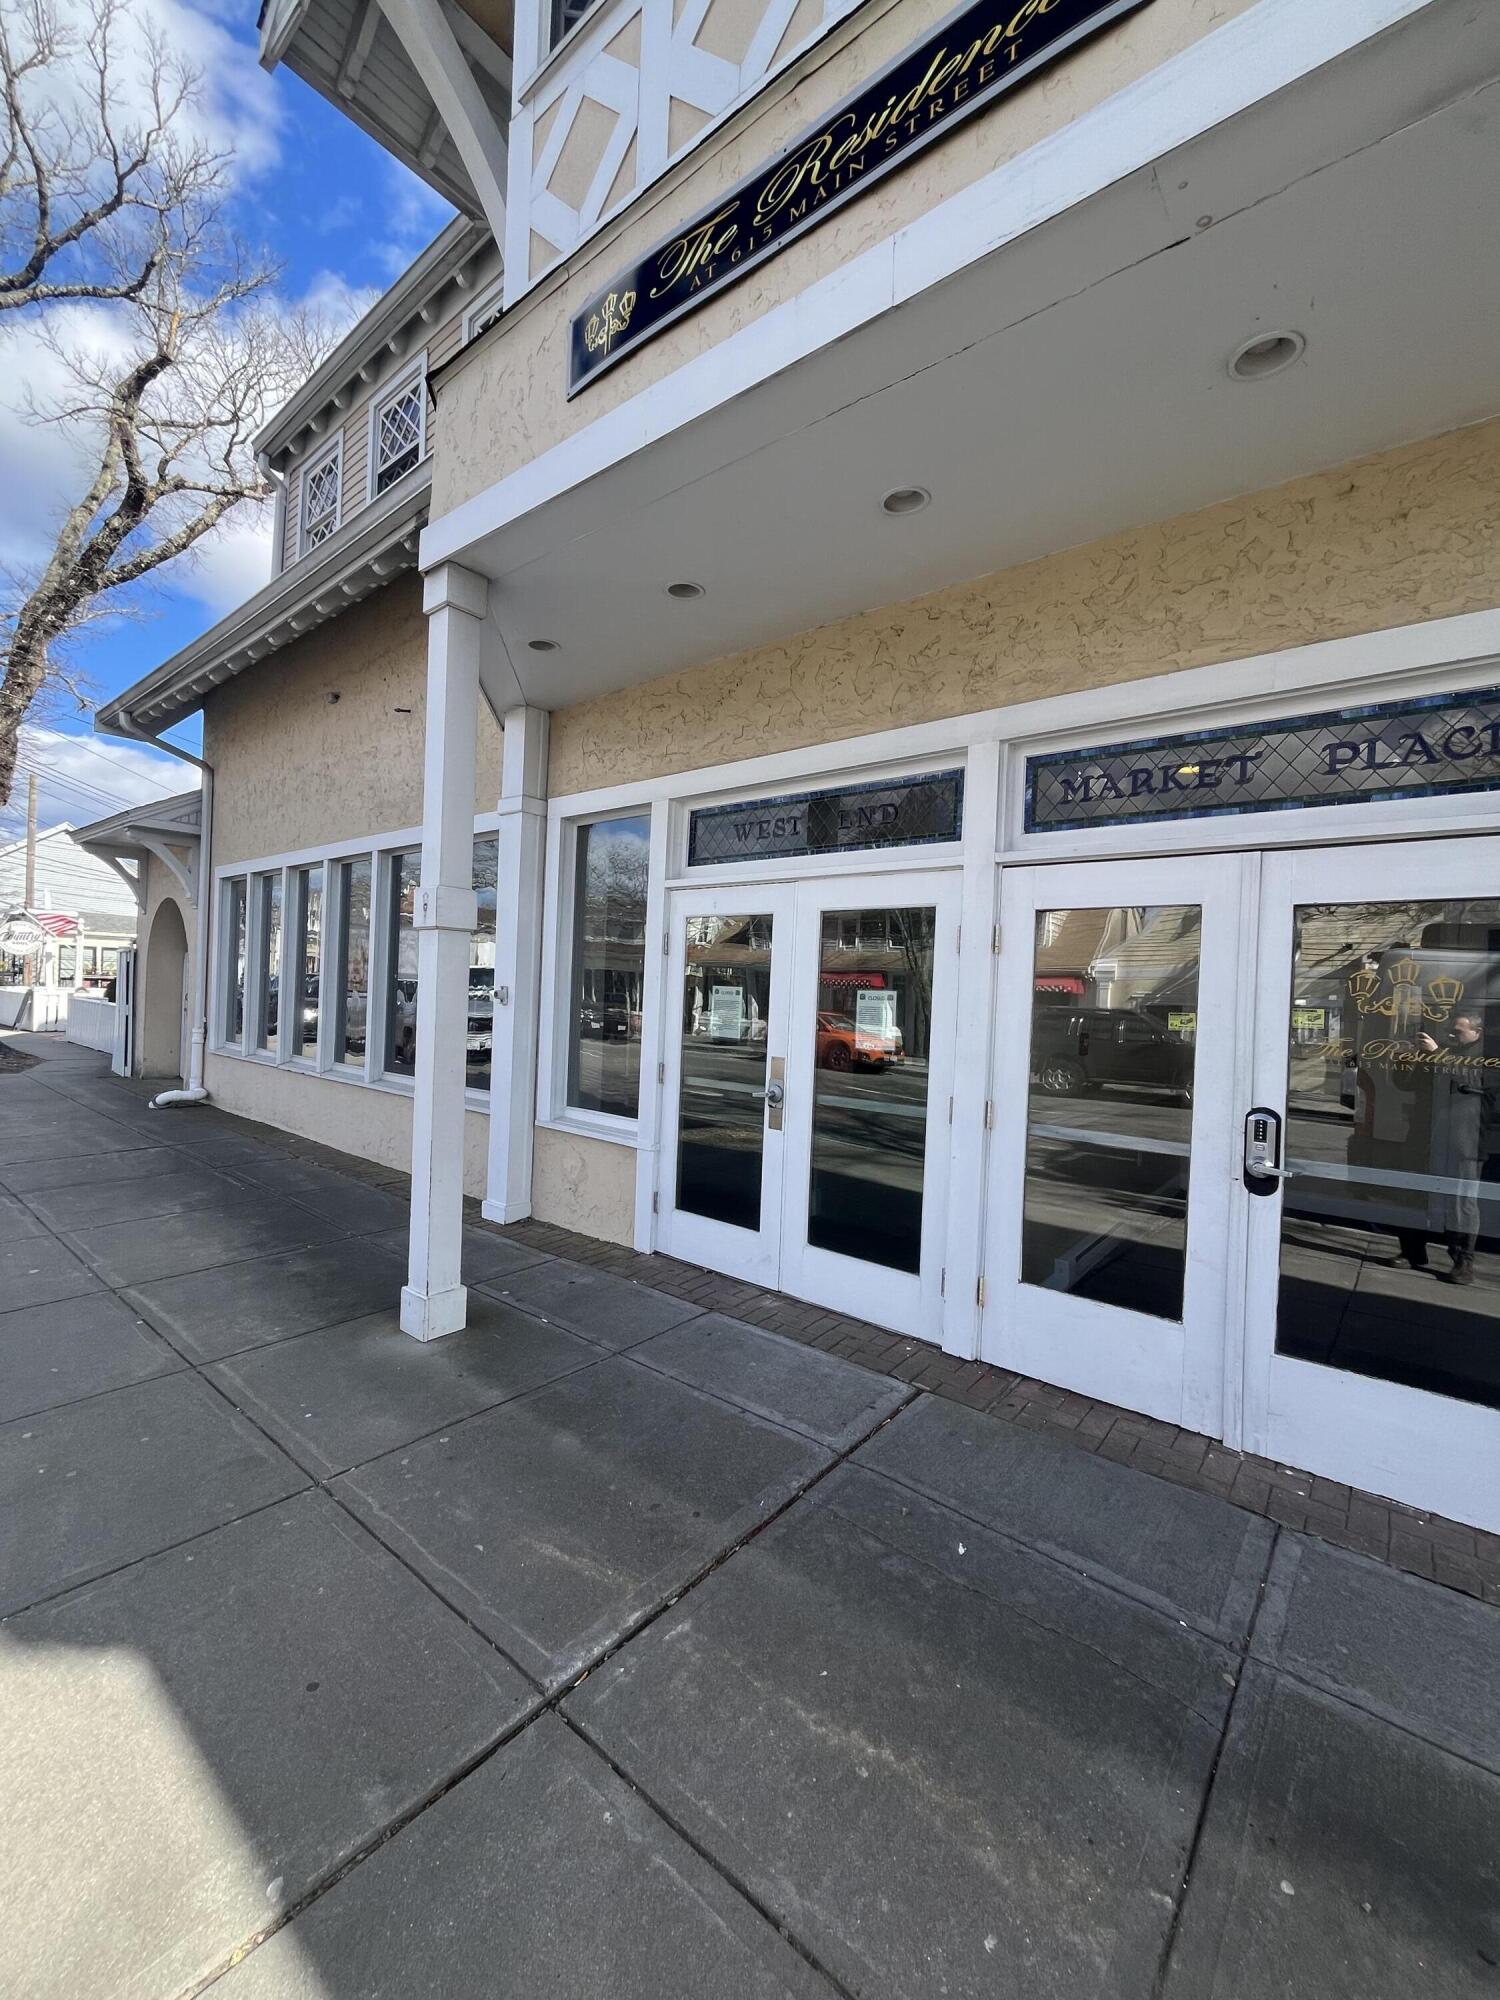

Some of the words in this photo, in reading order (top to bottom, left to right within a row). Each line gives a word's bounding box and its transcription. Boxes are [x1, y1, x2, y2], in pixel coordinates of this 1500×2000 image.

[689, 263, 717, 291] AT
[731, 224, 772, 262] 615
[789, 155, 865, 222] MAIN
[884, 38, 1023, 152] STREET
[649, 201, 740, 298] The
[1060, 750, 1263, 806] MARKET
[733, 815, 802, 843] WEST
[837, 802, 900, 830] END
[1311, 1038, 1354, 1058] The
[1380, 1062, 1415, 1072] MAIN
[1423, 1065, 1483, 1076] STREET
